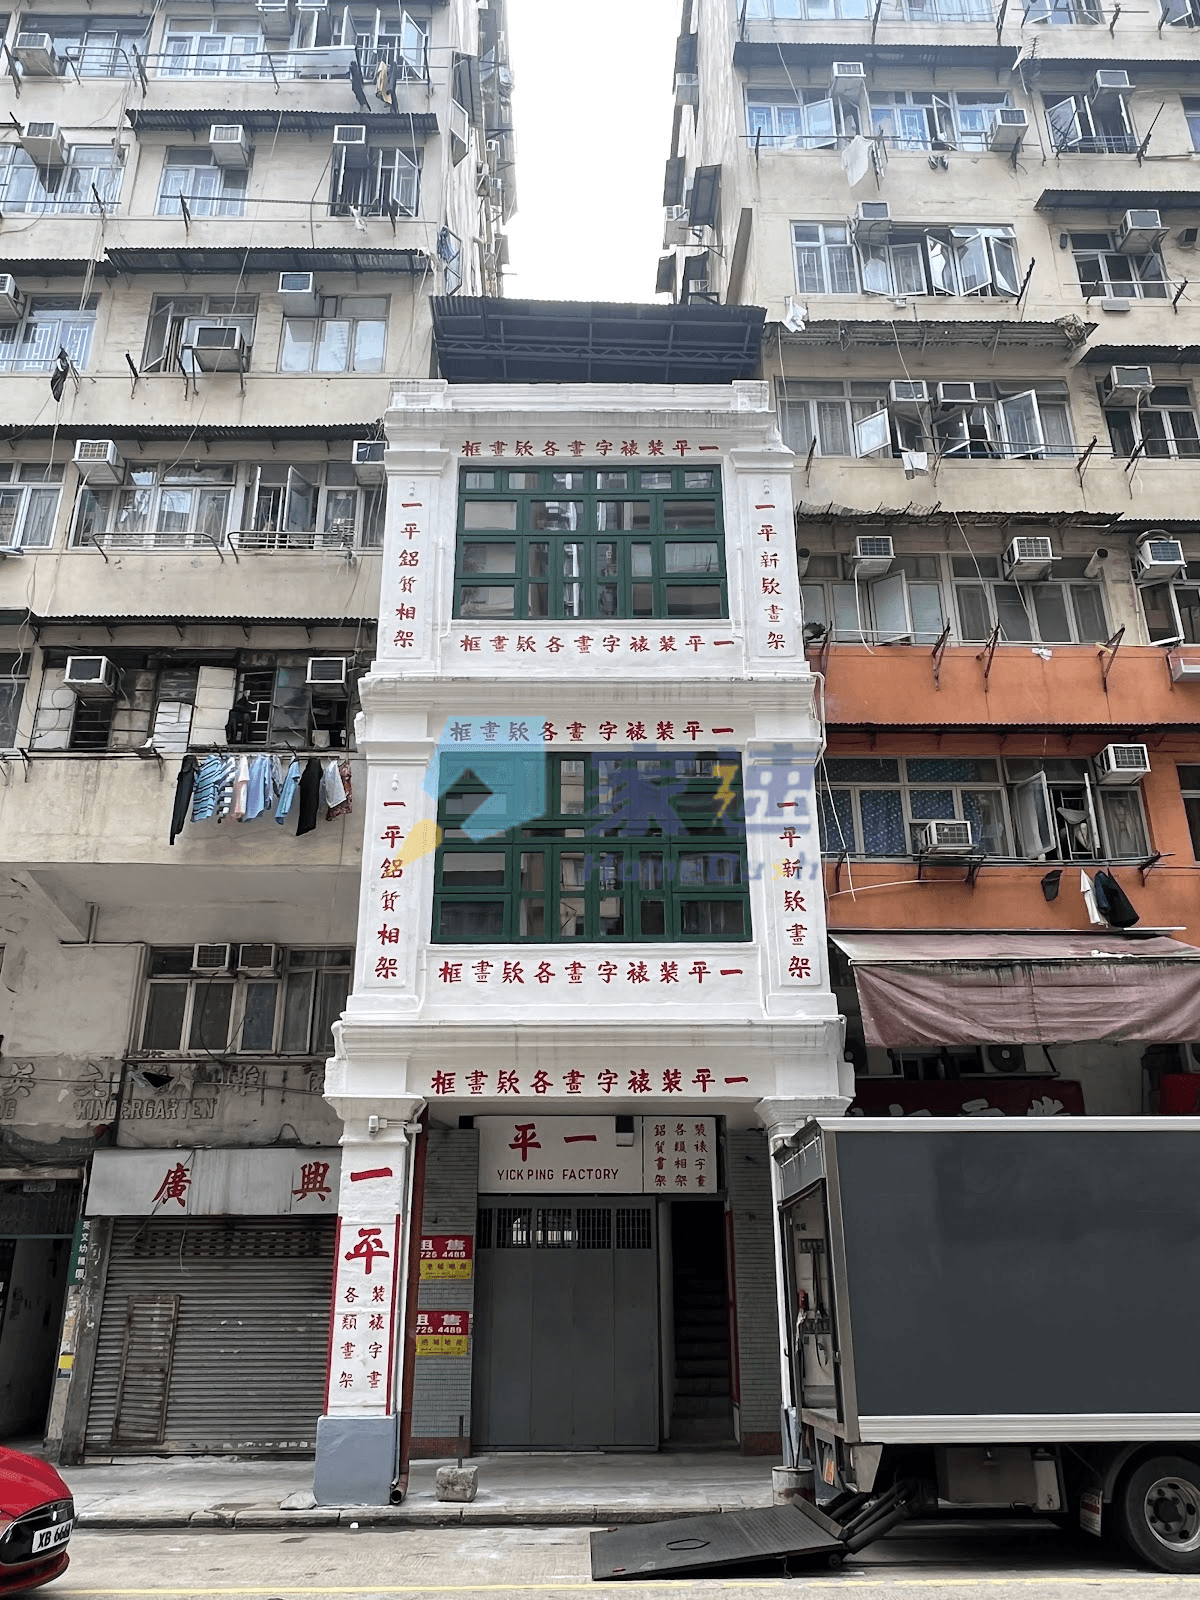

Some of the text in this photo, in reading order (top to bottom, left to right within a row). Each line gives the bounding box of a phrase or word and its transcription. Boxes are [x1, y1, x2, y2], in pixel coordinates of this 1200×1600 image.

[497, 1168, 619, 1180] YICK PING FACTORY
[38, 1530, 52, 1549] XB
